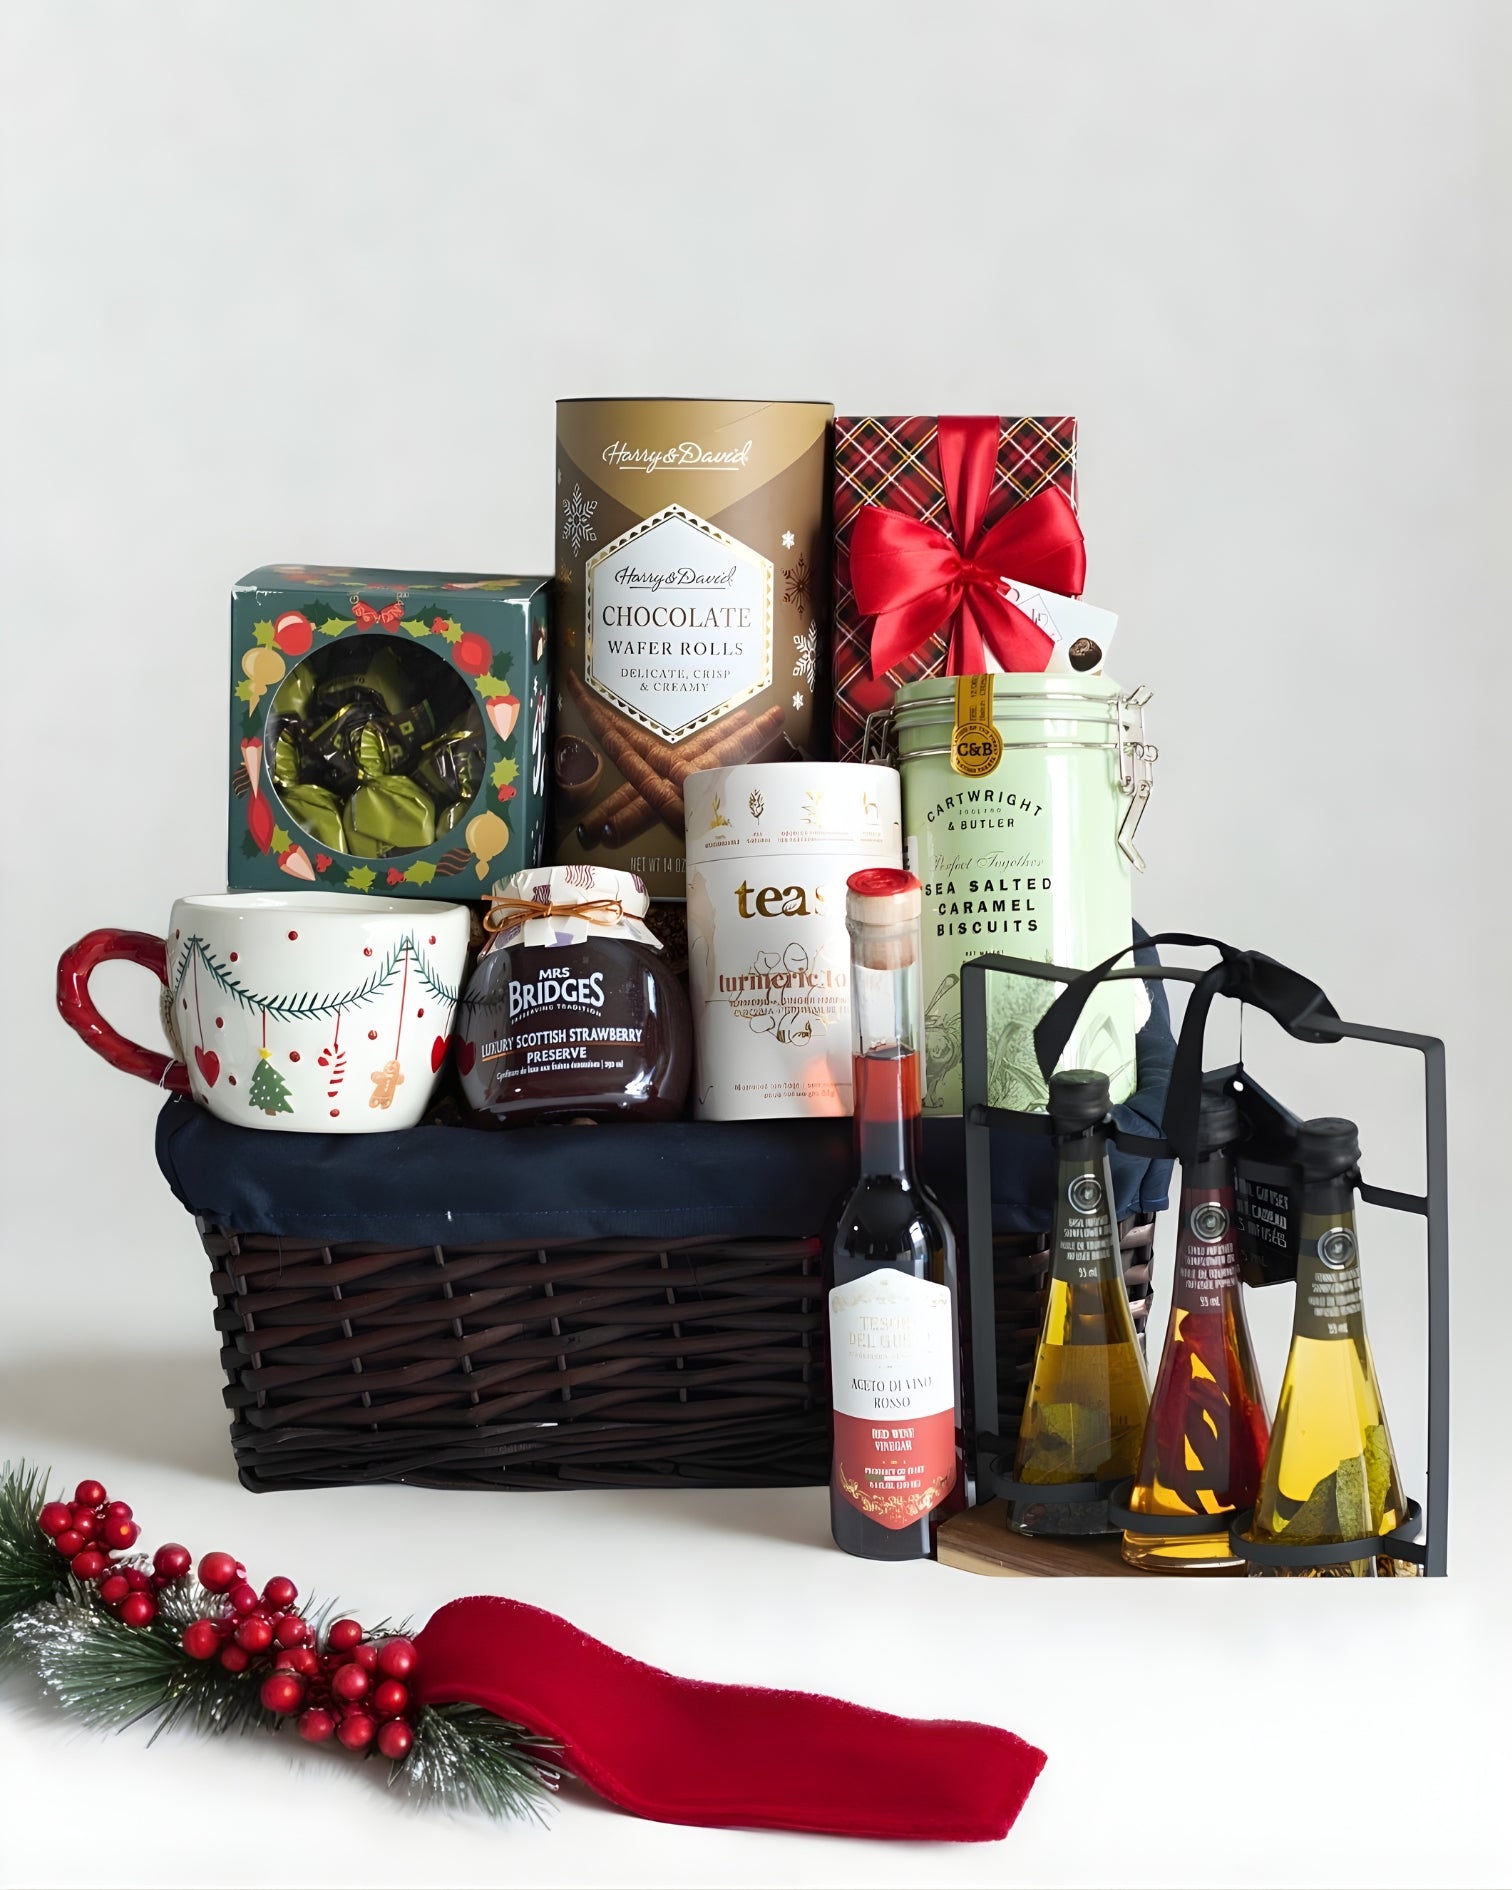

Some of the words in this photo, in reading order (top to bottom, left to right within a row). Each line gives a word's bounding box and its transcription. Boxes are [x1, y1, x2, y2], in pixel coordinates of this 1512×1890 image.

[602, 605, 752, 628] CHOCOLATE
[607, 640, 673, 655] WAFER
[680, 642, 743, 656] ROLLS
[693, 669, 731, 679] CRISP
[653, 683, 709, 692] CREAMY
[957, 742, 993, 757] C&B
[927, 789, 1042, 822] CARTWRIGHT
[960, 818, 1014, 830] BUTLER
[630, 856, 646, 872] NET
[925, 881, 956, 896] SEA
[969, 877, 1052, 895] SALTED
[938, 899, 1035, 916] CARAMEL
[936, 919, 1038, 936] BISCUITS
[538, 967, 570, 980] MRS
[508, 971, 605, 1018] BRIDGES
[481, 1036, 514, 1058] LUXURY
[516, 1028, 567, 1049] SCOTTISH
[569, 1027, 643, 1043] STRAWBERRY
[526, 1046, 587, 1064] PRESERVE
[851, 1378, 885, 1392] ACETO
[889, 1380, 901, 1392] DI
[874, 1396, 911, 1409] ROSSO
